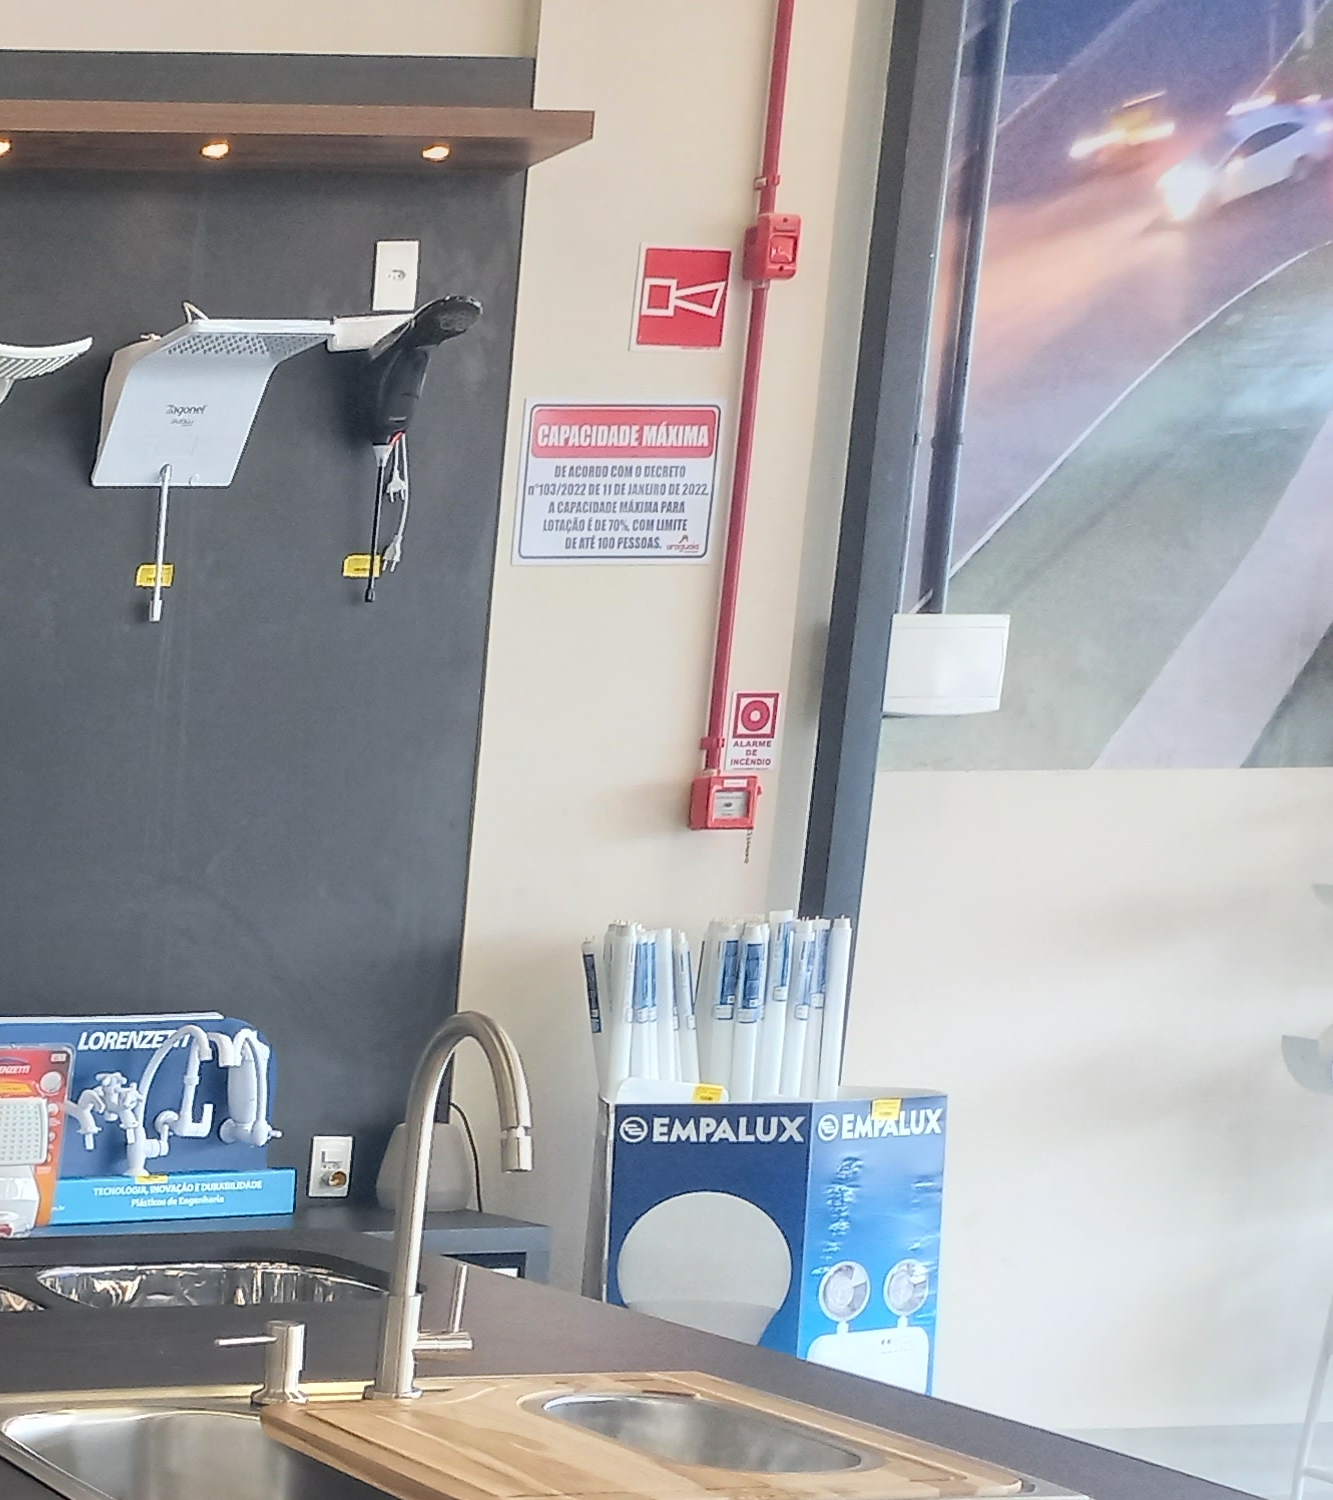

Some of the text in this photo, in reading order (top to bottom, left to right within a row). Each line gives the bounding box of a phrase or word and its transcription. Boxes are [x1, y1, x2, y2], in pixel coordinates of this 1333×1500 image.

[537, 421, 709, 448] CAPACIDADE MÁXIMA
[554, 465, 686, 478] DE ACORDO COM O DECRETO
[588, 483, 601, 496] DE
[602, 483, 611, 496] 11
[613, 483, 627, 496] DE
[627, 483, 666, 496] JANEIRO
[668, 483, 681, 496] DE
[548, 499, 686, 514] A CAPACIDADE MÁXIMA PARA
[542, 517, 584, 534] LOTAÇÃO
[587, 516, 594, 532] É
[594, 519, 607, 532] DE
[632, 519, 655, 532] COM
[656, 519, 688, 532] LIMITE
[564, 534, 662, 550] DE ATÉ 100 PESSOAS.
[732, 740, 772, 748] ALARME
[745, 749, 758, 757] DE
[730, 757, 772, 767] INCÊNDIO
[652, 1115, 806, 1144] EMPALUX
[841, 1106, 943, 1140] EMPALUX
[201, 1180, 263, 1191] DURABILIDADE
